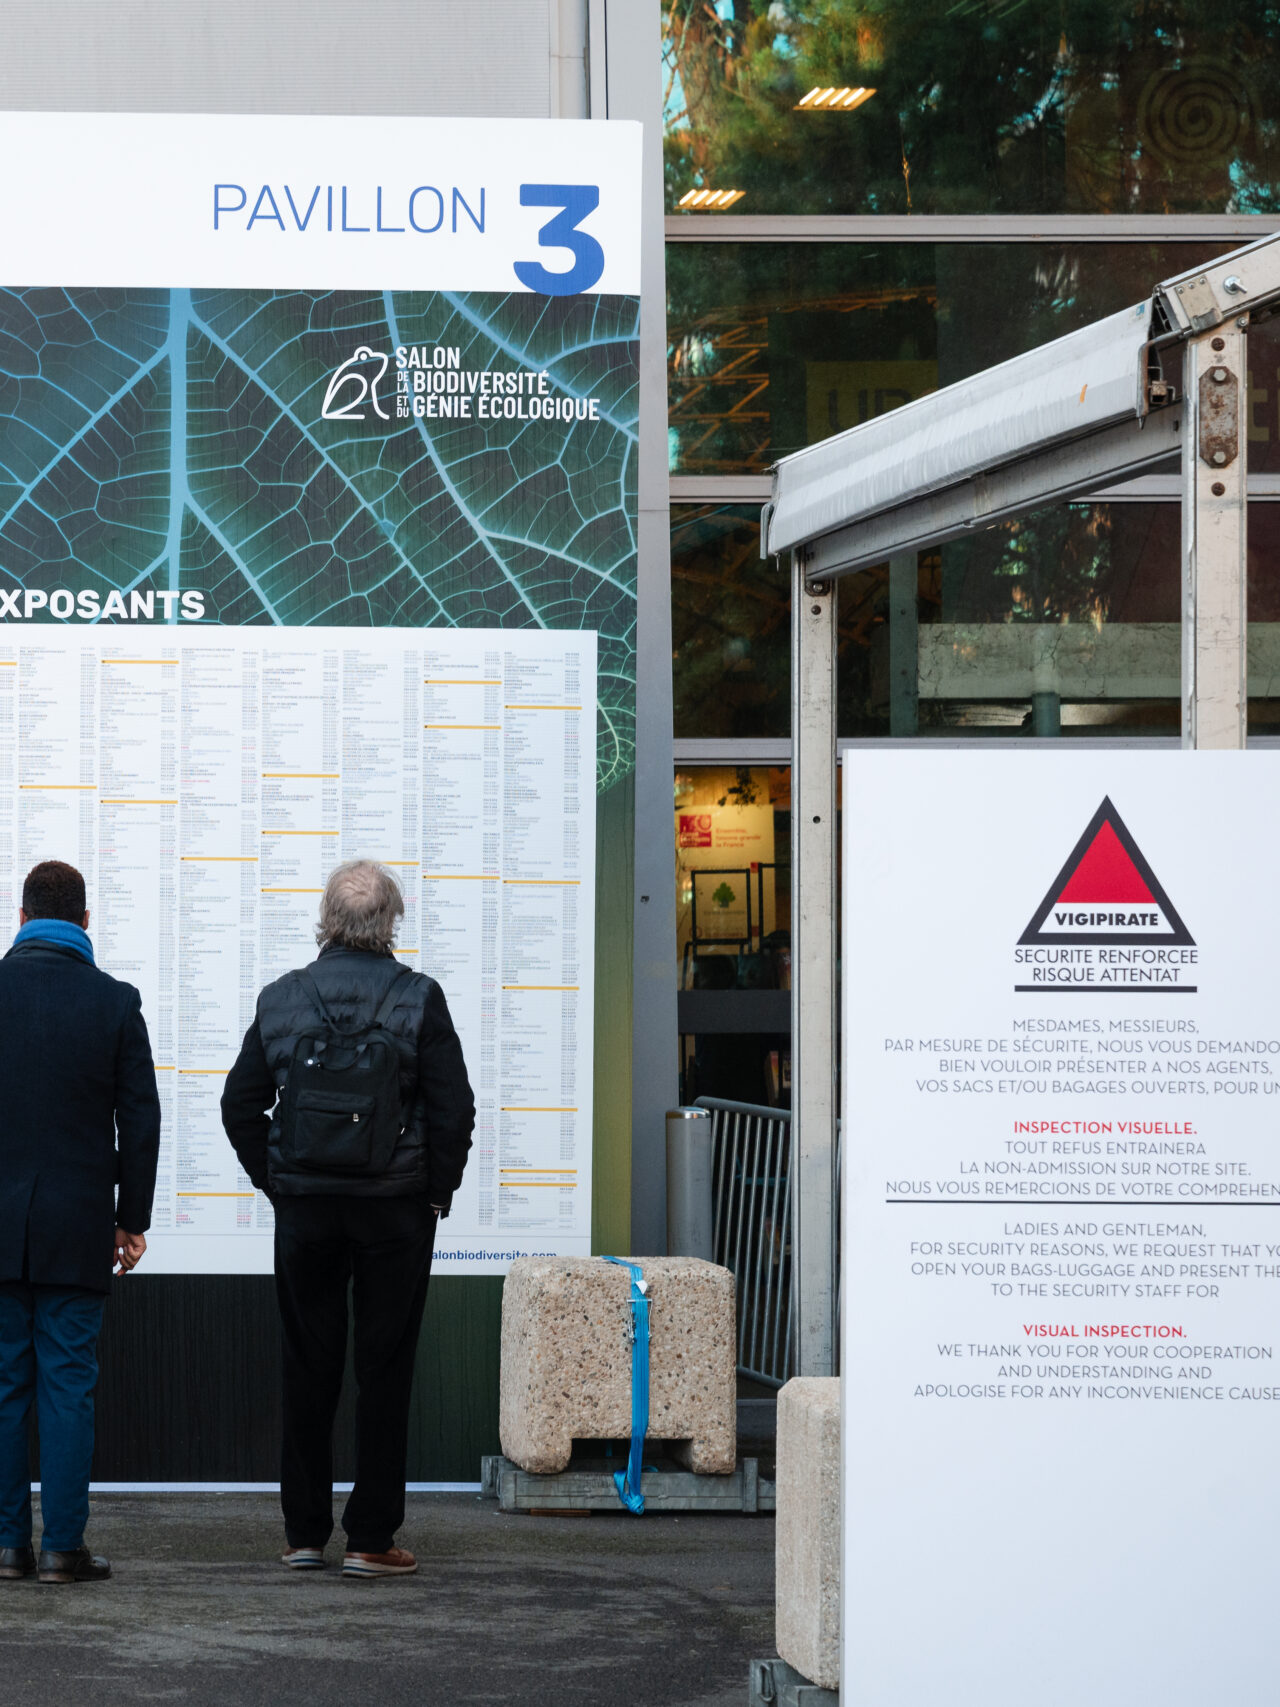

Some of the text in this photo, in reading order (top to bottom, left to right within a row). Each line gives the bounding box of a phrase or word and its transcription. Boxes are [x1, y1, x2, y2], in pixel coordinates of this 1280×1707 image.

[214, 184, 605, 297] PAVILLON 3
[395, 346, 460, 369] SALON
[413, 369, 549, 394] BIODIVERSITÉ
[413, 393, 600, 422] GÉNIE ÉCOLOGIQUE
[1054, 913, 1160, 926] VIGIPIRATE
[1014, 949, 1198, 964] SECURITE RENFORCEE
[1032, 968, 1180, 983] RISQUE ATTENTAT
[1014, 1019, 1200, 1034] MESDAMES, MESSIEURS,
[884, 1039, 914, 1052] PAR
[920, 1039, 982, 1052] MESURE
[988, 1039, 1008, 1053] DE
[1098, 1039, 1144, 1054] NOUS
[1148, 1040, 1192, 1053] VOUS
[940, 1058, 1272, 1074] BIEN VOULOIR PRÉSENTER A NOS AGENTS,
[916, 1080, 948, 1093] VOS
[954, 1080, 994, 1093] SACS
[998, 1079, 1046, 1095] ET/OU
[1052, 1080, 1126, 1094] BAGAGES
[1132, 1080, 1208, 1095] OUVERTS,
[1214, 1081, 1258, 1095] POUR
[1014, 1121, 1196, 1135] INSPECTION VISUELLE.
[1006, 1141, 1206, 1155] TOUT REFUS ENTRAINERA
[960, 1161, 1252, 1176] LA NON-ADMISSION SUR NOTRE SITE.
[886, 1181, 932, 1194] NOUS
[936, 1181, 980, 1194] VOUS
[986, 1181, 1090, 1195] REMERCIONS
[1096, 1182, 1116, 1195] DE
[1122, 1182, 1172, 1196] VOTRE
[1004, 1222, 1206, 1237] LADIES AND GENTLEMAN,
[910, 1242, 942, 1255] FOR
[948, 1242, 1024, 1255] SECURITY
[1030, 1243, 1108, 1257] REASONS,
[1112, 1243, 1138, 1256] WE
[1144, 1243, 1216, 1257] REQUEST
[1220, 1244, 1260, 1257] THAT
[912, 1263, 956, 1275] OPEN
[962, 1262, 1006, 1276] YOUR
[1010, 1262, 1136, 1277] BAGS-LUGGAGE
[1140, 1263, 1174, 1278] AND
[1180, 1264, 1250, 1278] PRESENT
[992, 1283, 1220, 1298] TO THE SECURITY STAFF FOR
[1024, 1325, 1186, 1338] VISUAL INSPECTION.
[938, 1344, 1272, 1359] WE THANK YOU FOR YOUR COOPERATION
[998, 1365, 1212, 1379] AND UNDERSTANDING AND
[914, 1384, 1006, 1397] APOLOGISE
[1012, 1385, 1044, 1398] FOR
[1050, 1386, 1082, 1398] ANY
[1088, 1385, 1224, 1400] INCONVENIENCE
